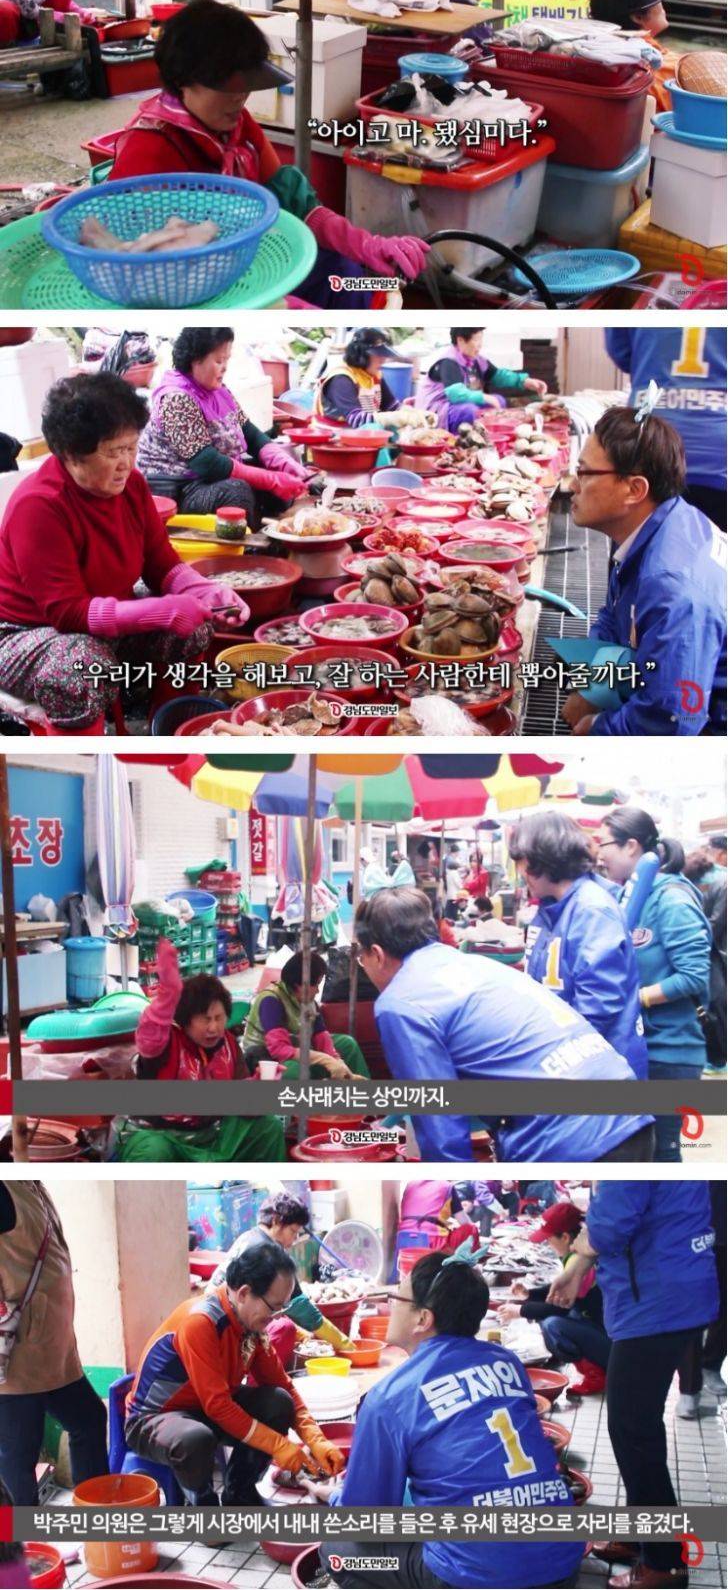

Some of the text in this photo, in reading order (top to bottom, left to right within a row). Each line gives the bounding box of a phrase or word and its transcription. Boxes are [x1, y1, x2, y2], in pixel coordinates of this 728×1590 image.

[9, 816, 64, 867] 초장
[543, 937, 565, 990] 1
[420, 1360, 528, 1422] 문재인
[485, 1407, 538, 1480] 1
